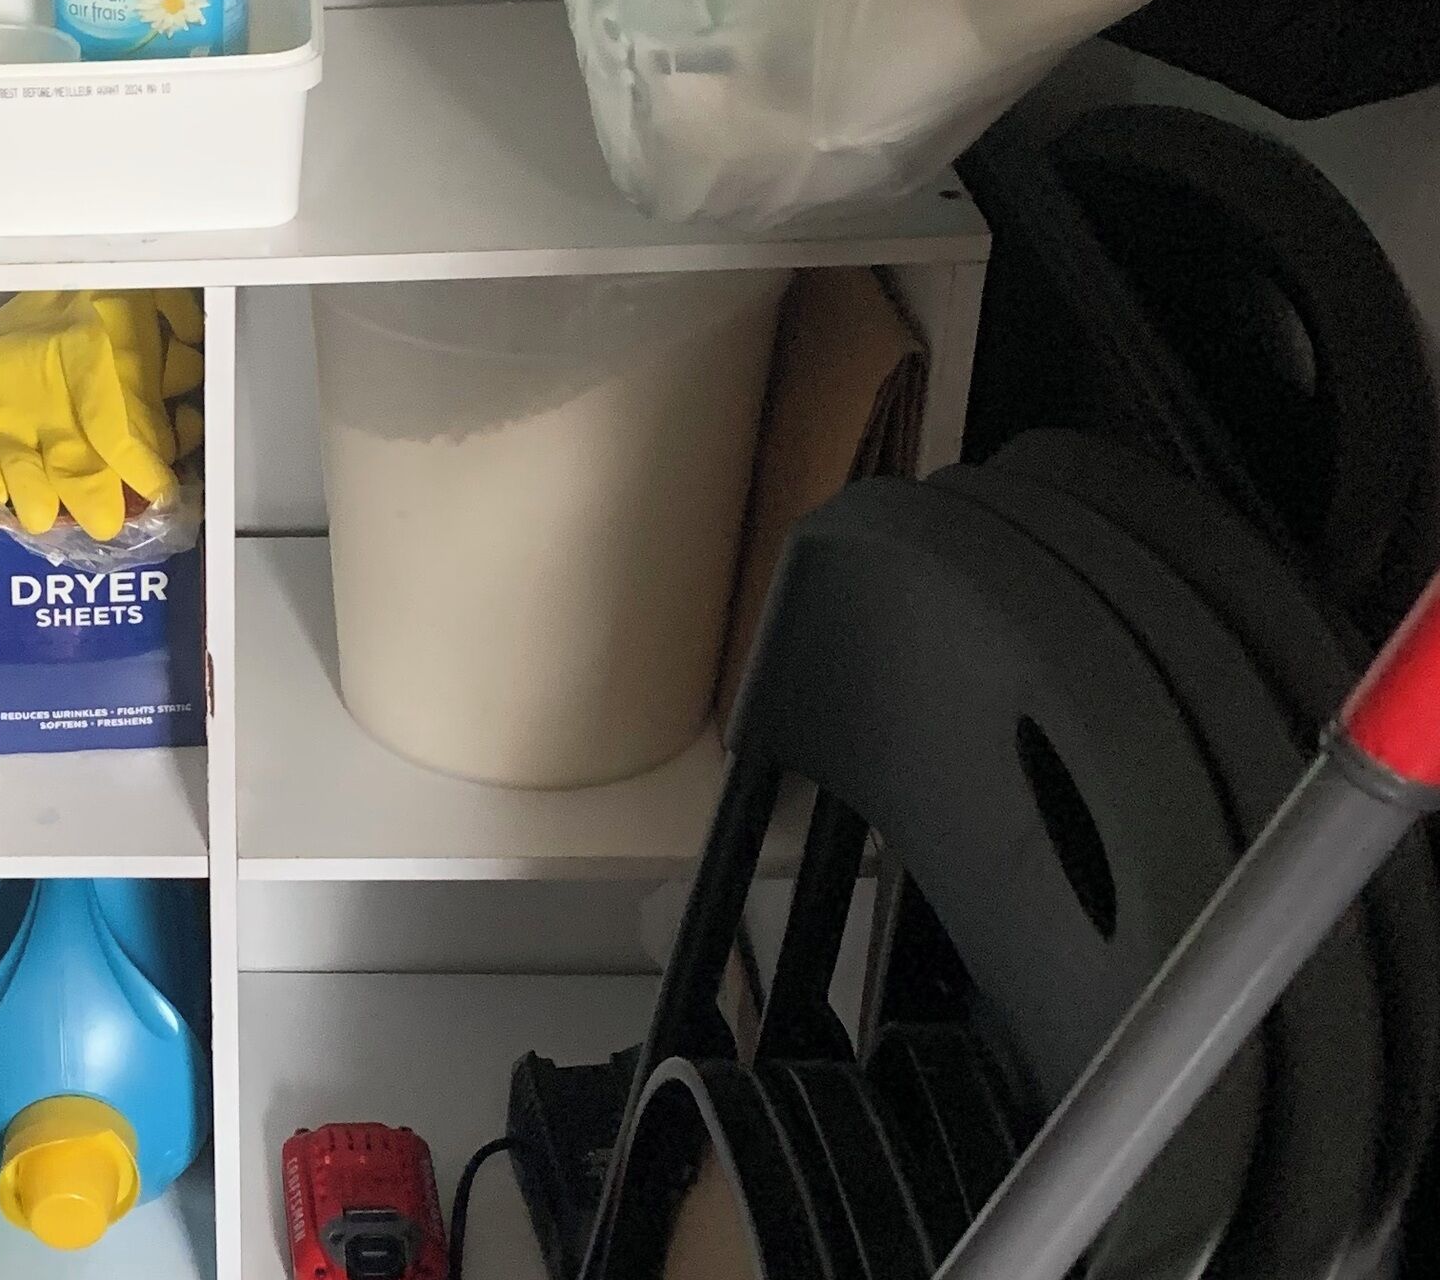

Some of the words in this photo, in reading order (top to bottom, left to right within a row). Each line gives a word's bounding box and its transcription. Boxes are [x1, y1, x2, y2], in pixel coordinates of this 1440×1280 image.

[68, 2, 89, 17] air
[92, 3, 127, 23] frais
[0, 87, 18, 99] BEST
[10, 571, 169, 606] DRYER
[35, 605, 144, 627] SHEETS
[0, 710, 50, 721] REDUCES
[52, 708, 109, 719] WRINKLES
[117, 705, 155, 716] FIGHTS
[157, 703, 192, 714] STATIC
[39, 720, 88, 730] SOFTENS
[96, 717, 153, 728] FRESHENS
[286, 1156, 307, 1243] CRAFTSMAN
